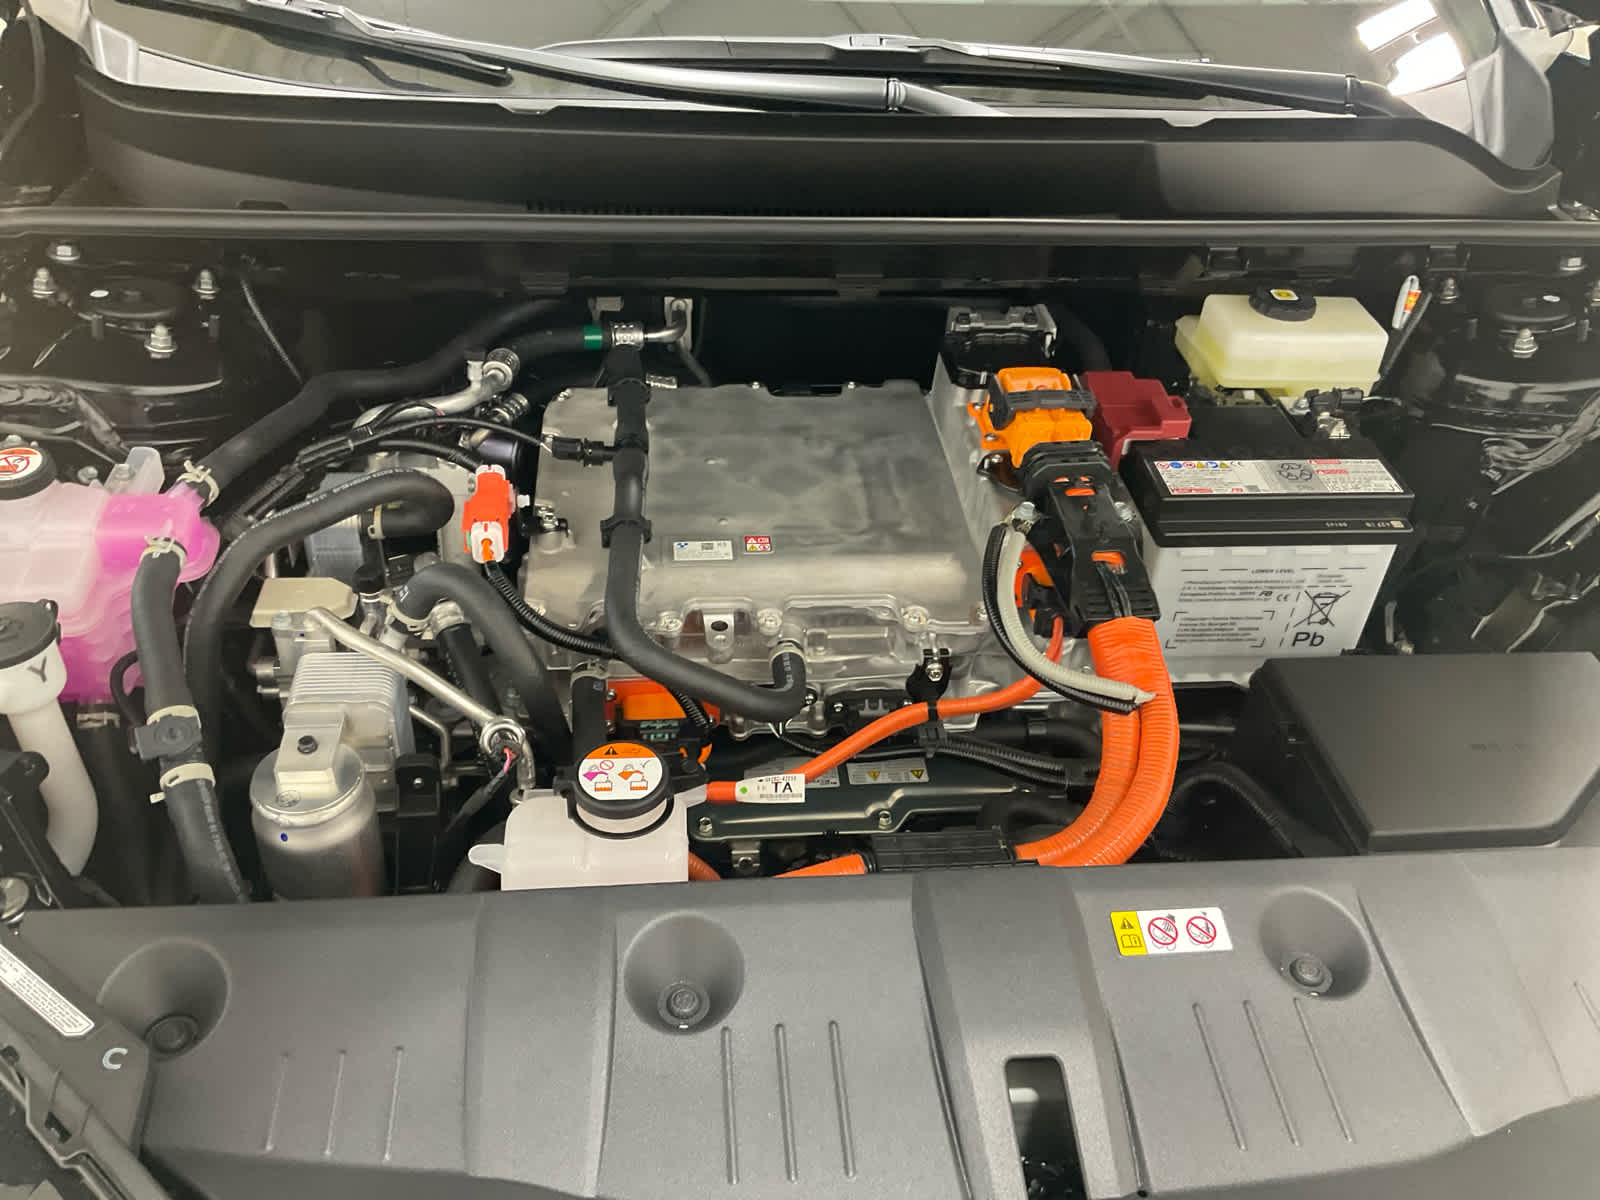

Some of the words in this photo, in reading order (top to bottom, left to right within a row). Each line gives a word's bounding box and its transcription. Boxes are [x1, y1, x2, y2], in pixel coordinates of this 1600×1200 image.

[1292, 631, 1325, 647] Pb
[771, 781, 793, 793] TA
[102, 1047, 129, 1070] C
